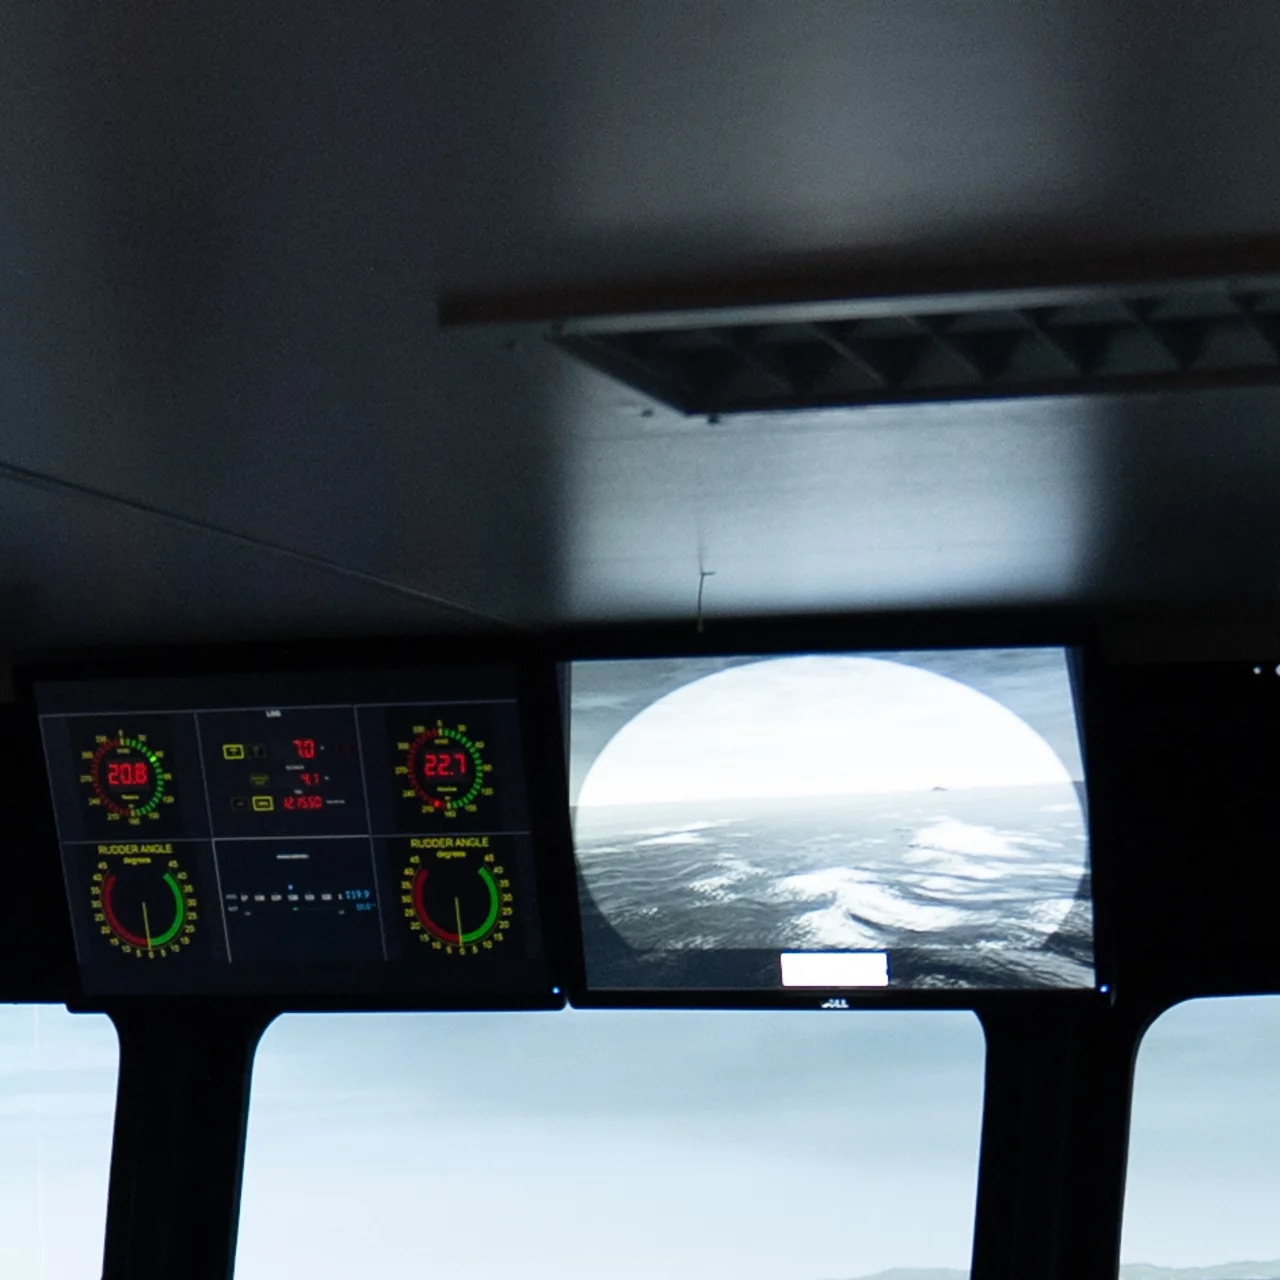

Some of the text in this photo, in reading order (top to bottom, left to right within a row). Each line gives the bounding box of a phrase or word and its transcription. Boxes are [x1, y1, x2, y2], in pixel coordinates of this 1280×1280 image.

[108, 761, 148, 786] 20.8
[423, 752, 468, 777] 22.7
[97, 844, 173, 855] RUDDER ANGLE
[410, 836, 490, 849] RUDDER ANGLE
